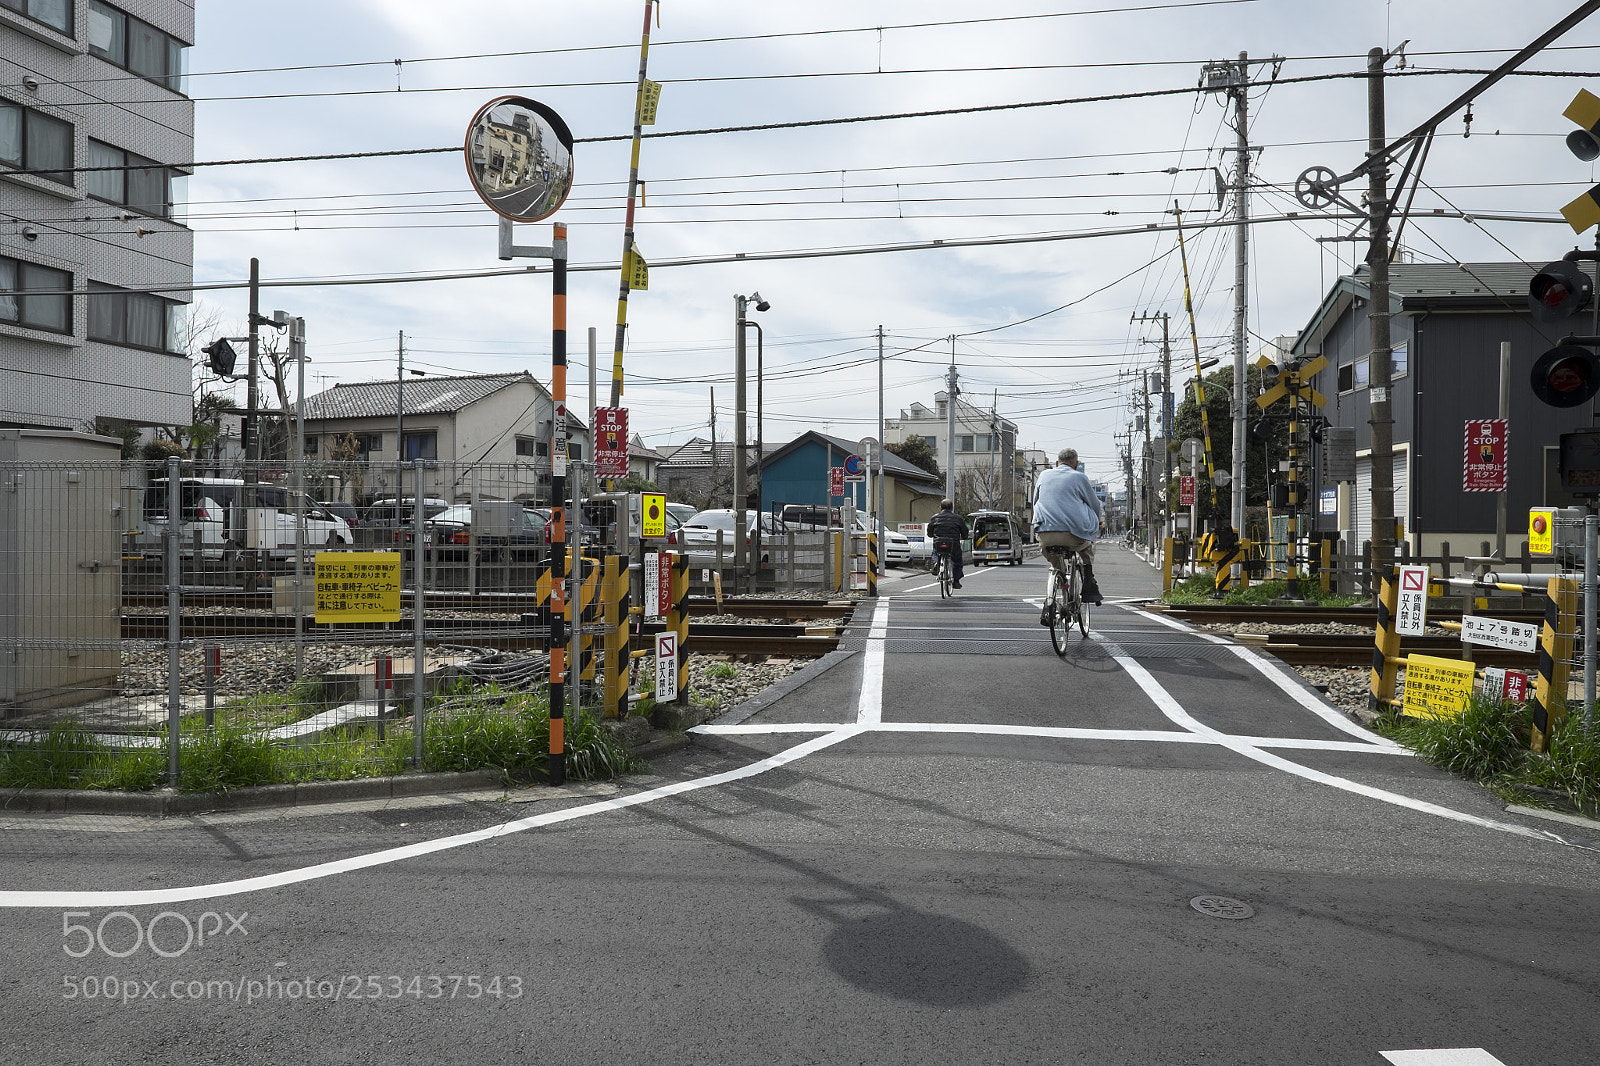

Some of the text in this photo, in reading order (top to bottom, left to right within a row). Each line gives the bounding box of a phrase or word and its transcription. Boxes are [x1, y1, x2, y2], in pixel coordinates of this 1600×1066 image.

[555, 418, 566, 452] 注意
[1473, 437, 1500, 445] STOP
[597, 450, 625, 458] 非常停止
[601, 457, 622, 465] ボタン
[1469, 463, 1503, 471] 非常停止
[317, 582, 398, 592] 自転車・車椅子・ベビーカー
[661, 556, 670, 611] 非常ボタン
[317, 601, 385, 610] 溝に注意して下さい。
[1400, 594, 1410, 629] 立入禁止
[1411, 594, 1422, 630] 係員以外
[1466, 621, 1533, 638] 池上7号踏切
